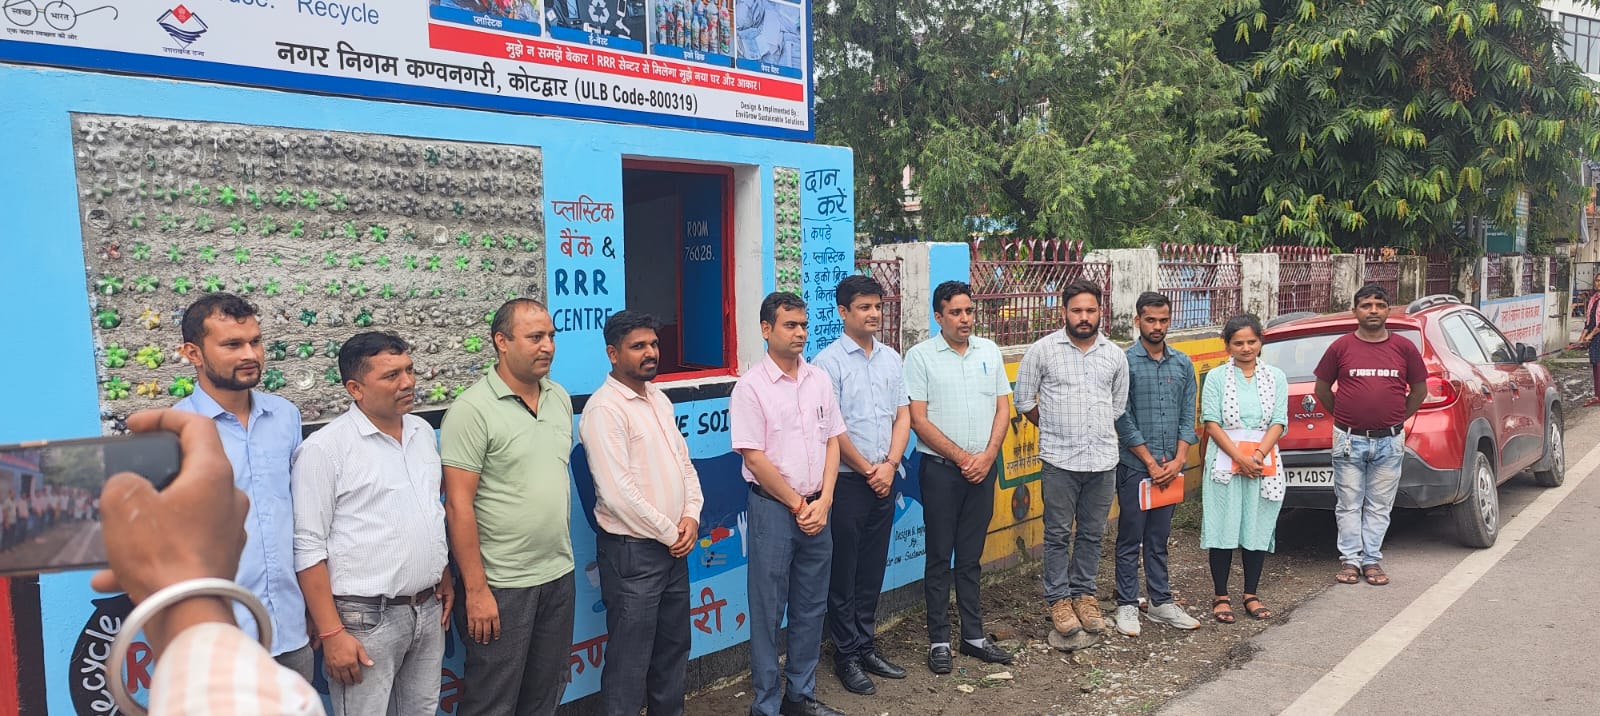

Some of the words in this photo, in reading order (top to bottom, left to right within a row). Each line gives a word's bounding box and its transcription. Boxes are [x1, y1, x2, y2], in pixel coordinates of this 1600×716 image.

[50, 12, 70, 20] भारत
[473, 15, 503, 29] प्लास्टिक
[505, 40, 524, 58] मुझे
[526, 45, 535, 57] न
[566, 48, 589, 65] बेकार
[597, 55, 616, 69] RRR
[618, 56, 640, 73] सेन्टर
[642, 60, 650, 74] से
[652, 61, 677, 78] मिलेगा
[679, 67, 693, 84] मुझे
[694, 72, 708, 83] नया
[710, 74, 721, 85] घर
[722, 73, 735, 87] और
[275, 41, 331, 68] नगर
[337, 40, 399, 76] निगम
[405, 58, 502, 94] कण्वनगरी,
[508, 66, 568, 98] कोटद्वार
[574, 77, 608, 102] (ULB
[612, 84, 699, 116] Code-800319)
[740, 101, 757, 112] Design
[758, 112, 784, 124] Sustainable
[785, 115, 805, 127] Solutions
[804, 168, 841, 193] दान
[551, 194, 615, 223] प्लास्टिक
[817, 187, 848, 217] करें
[687, 220, 709, 238] ROOM
[560, 228, 594, 258] बैंक
[601, 236, 616, 259] &
[813, 246, 846, 265] प्लास्टिक
[554, 268, 609, 297] RRR
[814, 267, 831, 286] इको
[816, 303, 836, 322] जूते
[1377, 369, 1389, 377] DO
[697, 408, 730, 435] SOI
[1294, 412, 1325, 420] KWID
